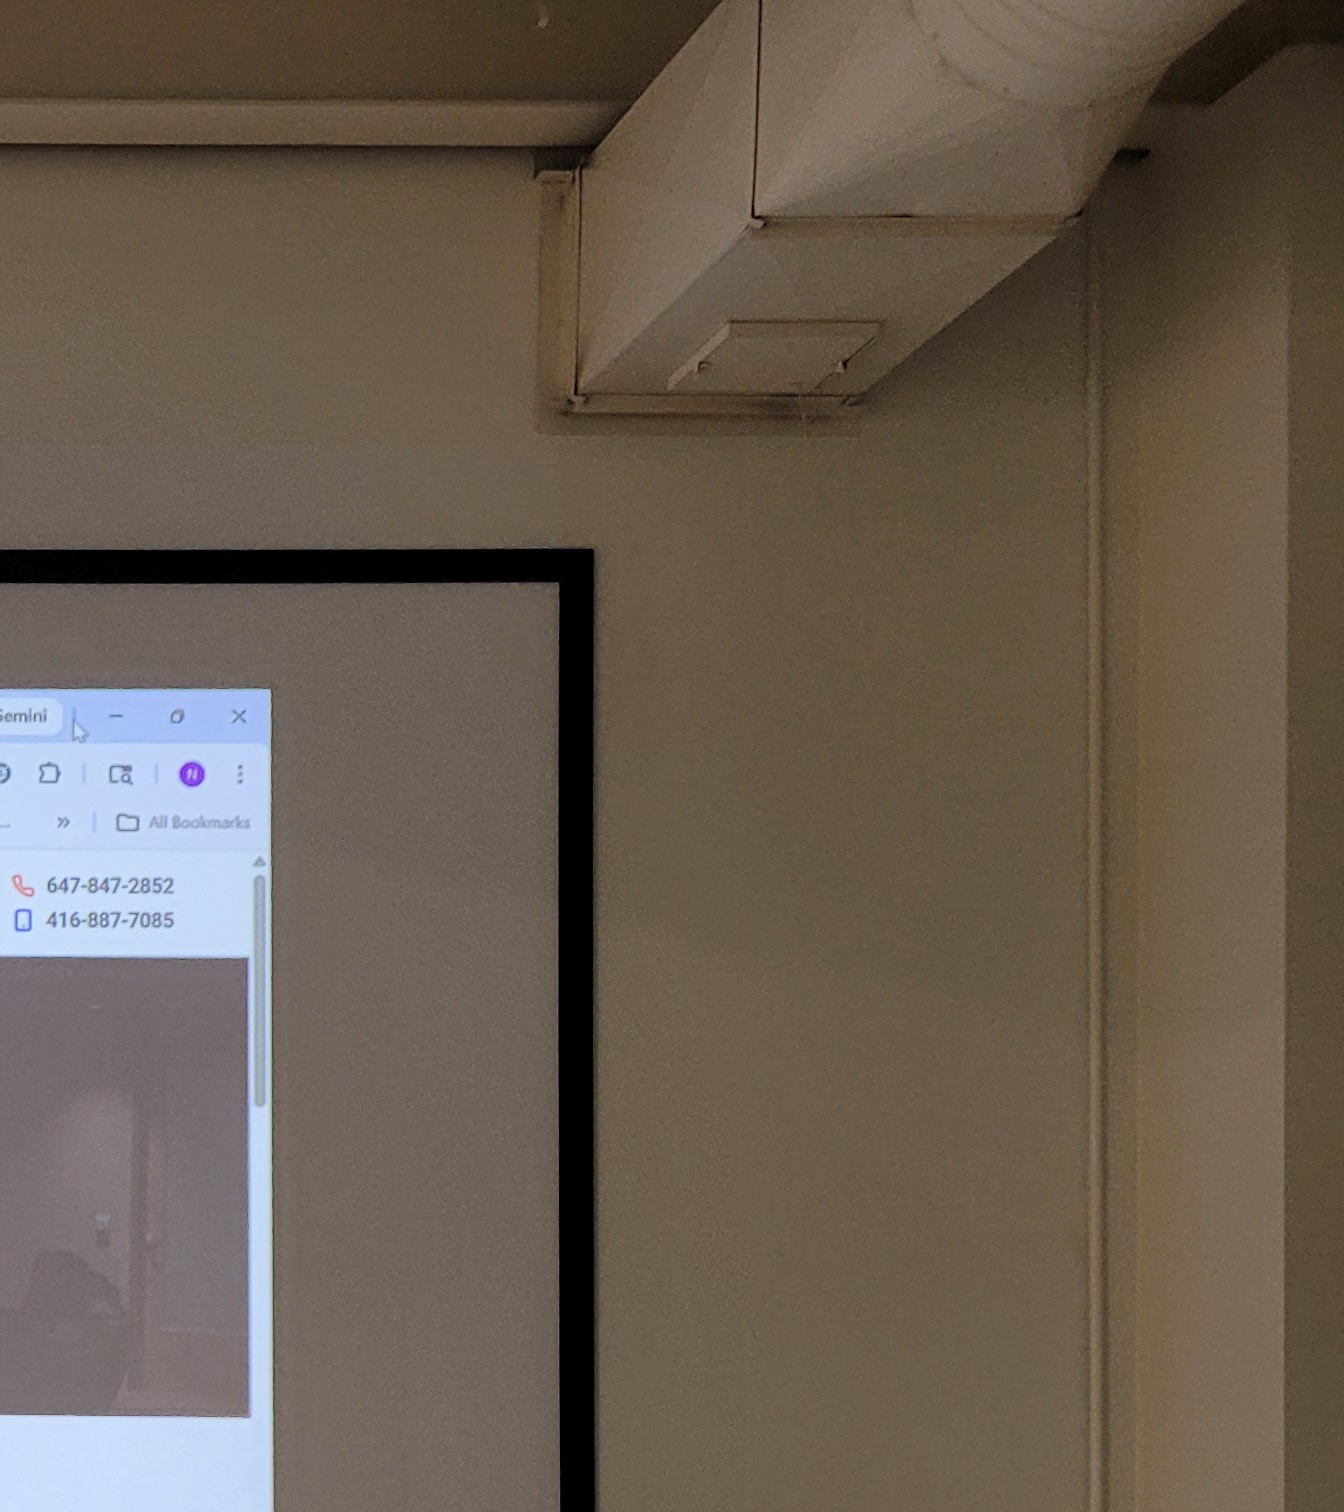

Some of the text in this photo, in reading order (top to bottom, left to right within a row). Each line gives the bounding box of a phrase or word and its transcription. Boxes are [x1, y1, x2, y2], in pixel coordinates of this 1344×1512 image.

[148, 814, 251, 831] All Bookmarks
[47, 876, 174, 895] 647-847-2852
[46, 911, 174, 930] 416-887-7085
